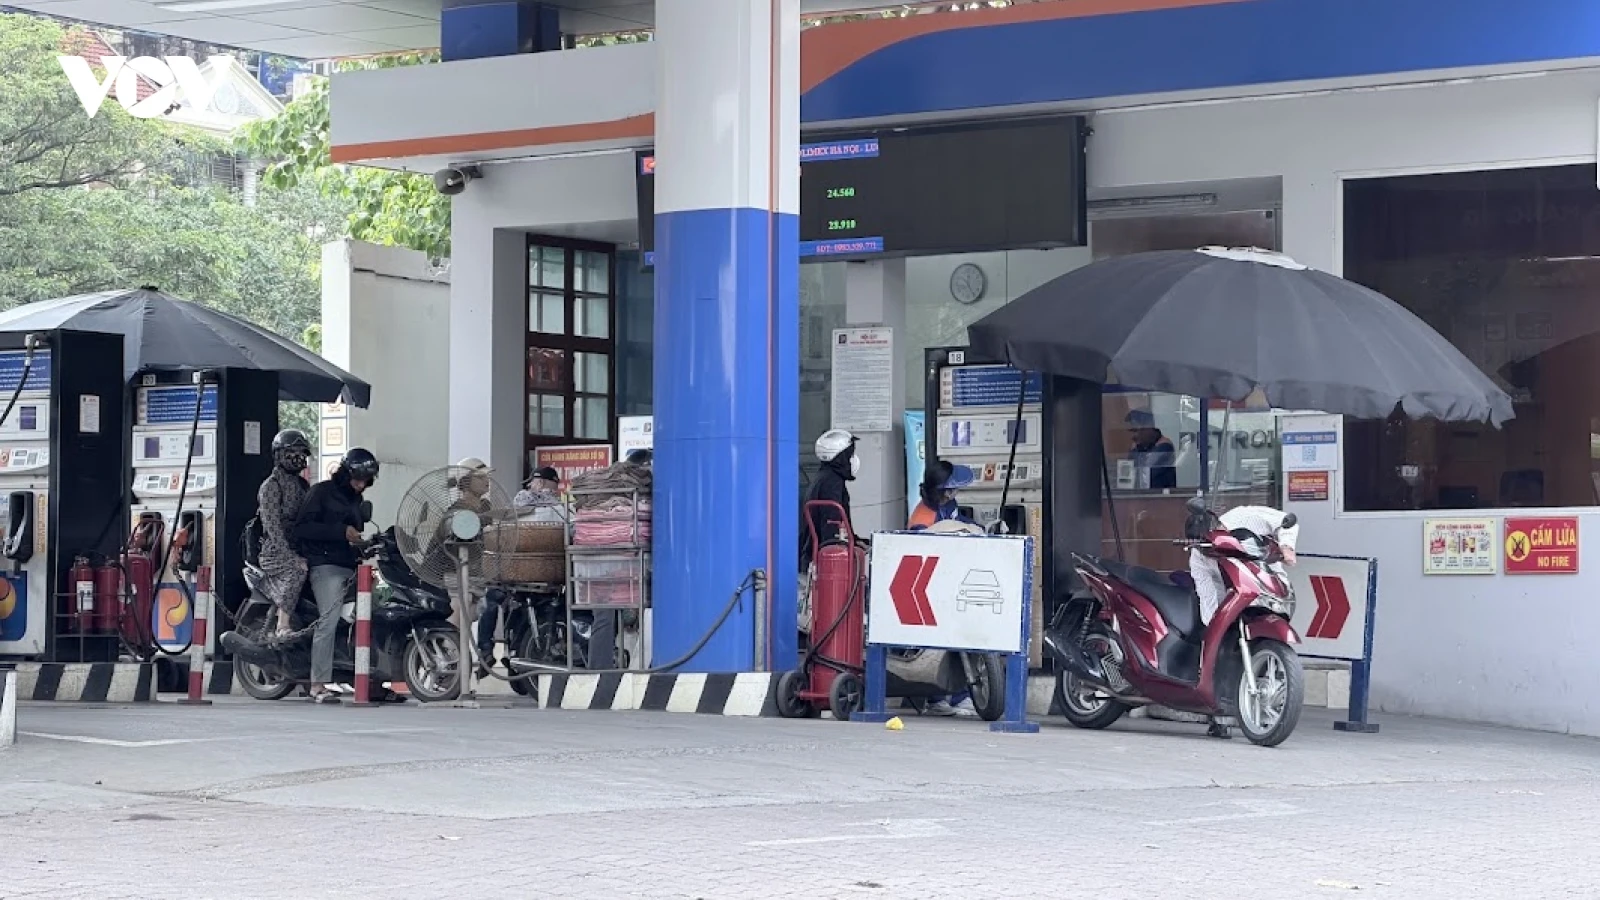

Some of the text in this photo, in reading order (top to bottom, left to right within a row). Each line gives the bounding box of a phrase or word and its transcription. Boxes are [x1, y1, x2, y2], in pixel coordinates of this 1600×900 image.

[951, 353, 962, 363] 18
[1531, 522, 1576, 546] CẤM LỬA
[1538, 556, 1570, 567] NO FIRE
